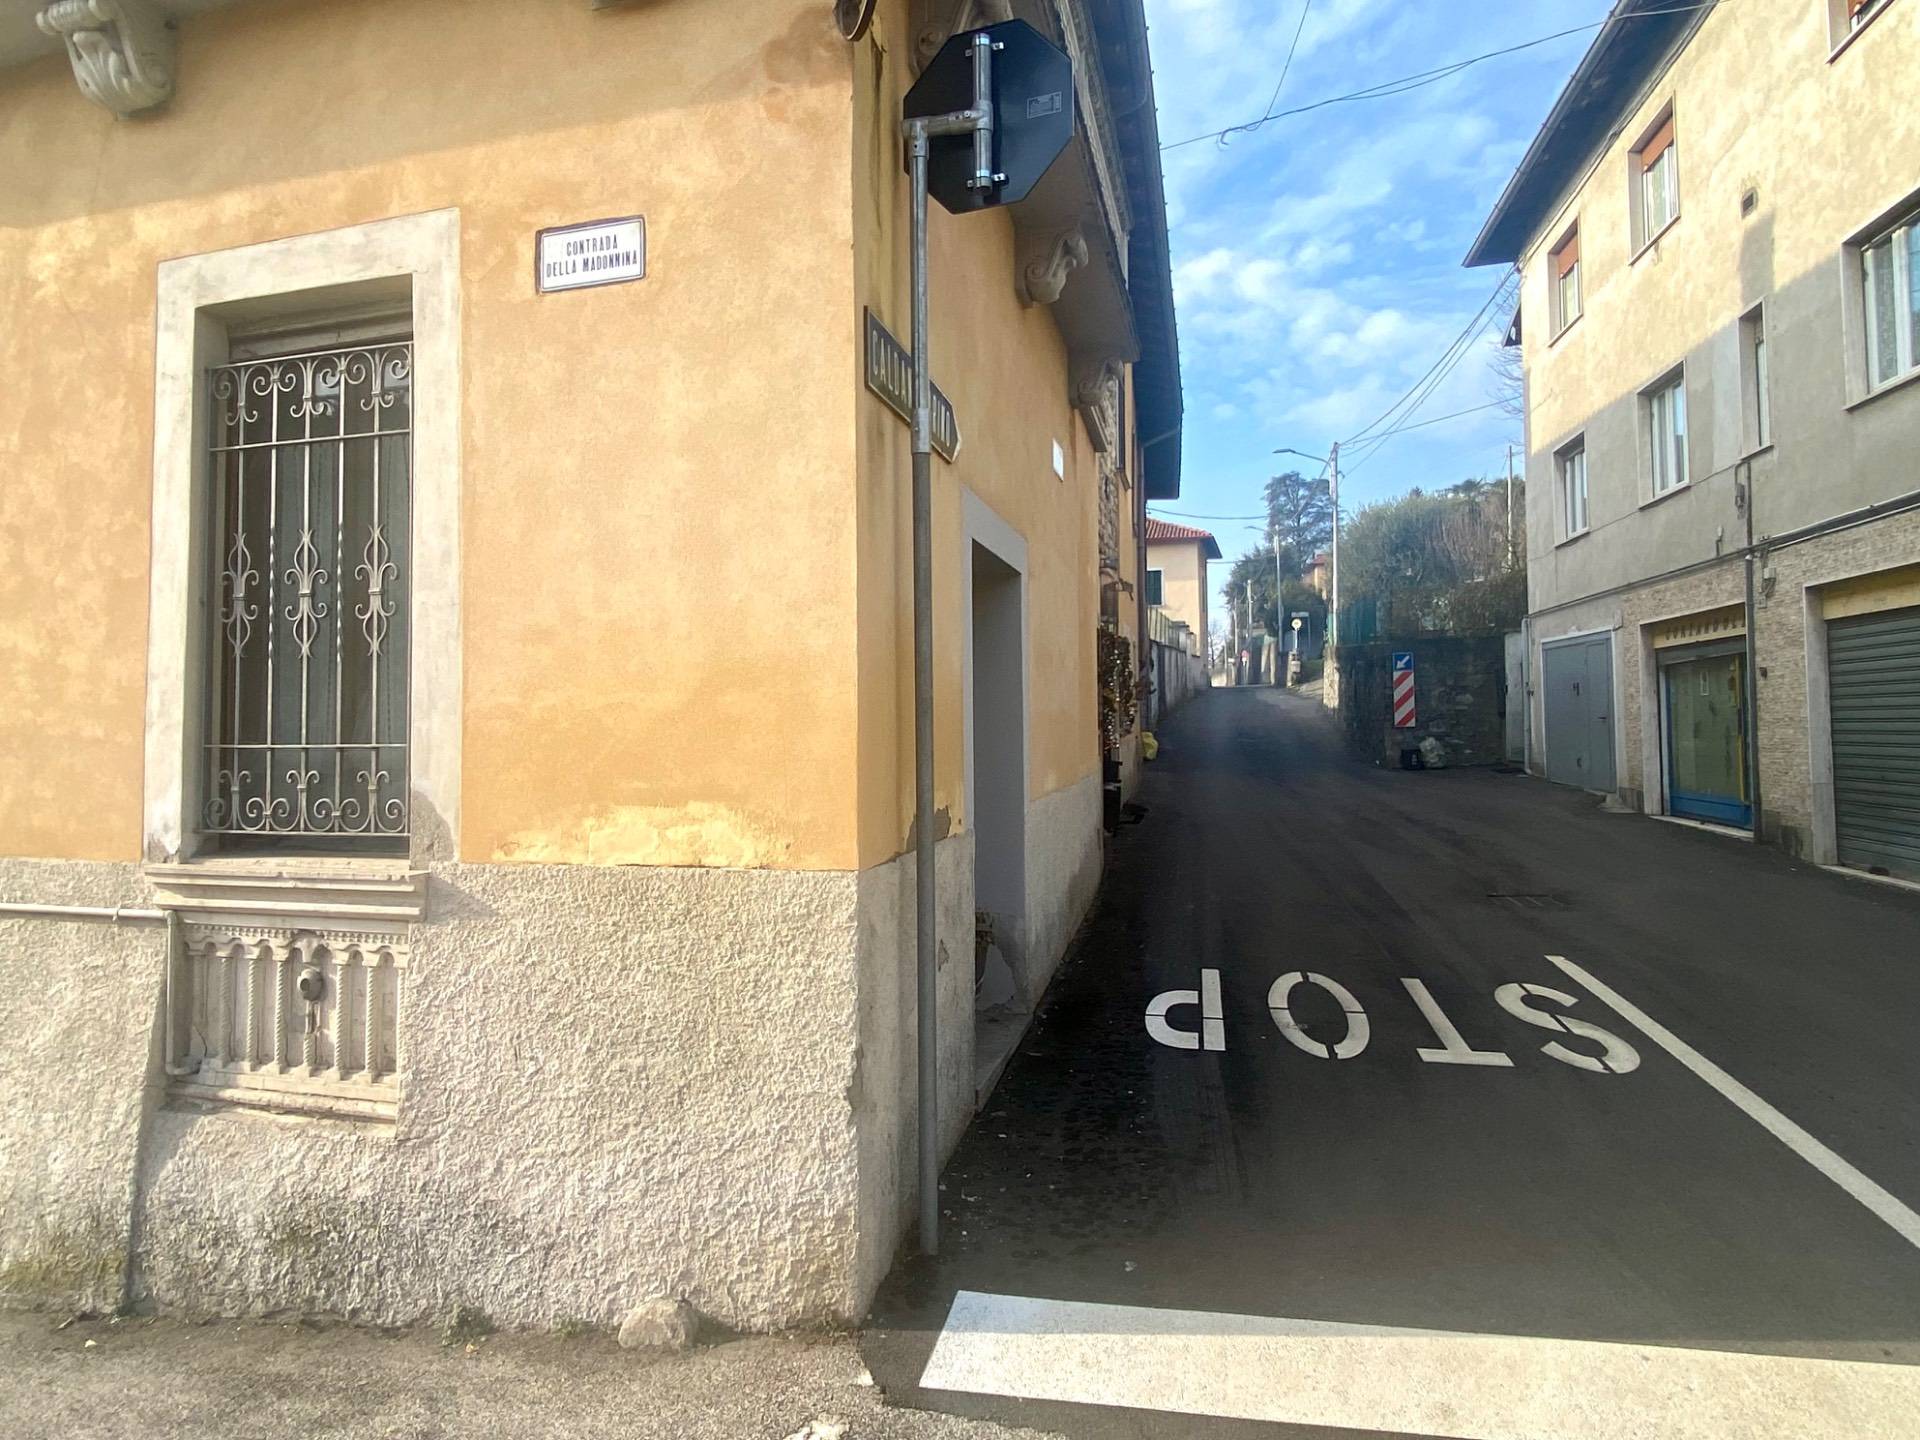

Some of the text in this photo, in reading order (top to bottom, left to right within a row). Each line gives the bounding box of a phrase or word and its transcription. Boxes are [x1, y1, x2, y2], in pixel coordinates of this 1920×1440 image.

[566, 234, 618, 256] CONTRADA
[546, 250, 638, 278] DELLA MADONNINA
[1144, 968, 1641, 1074] STOP
